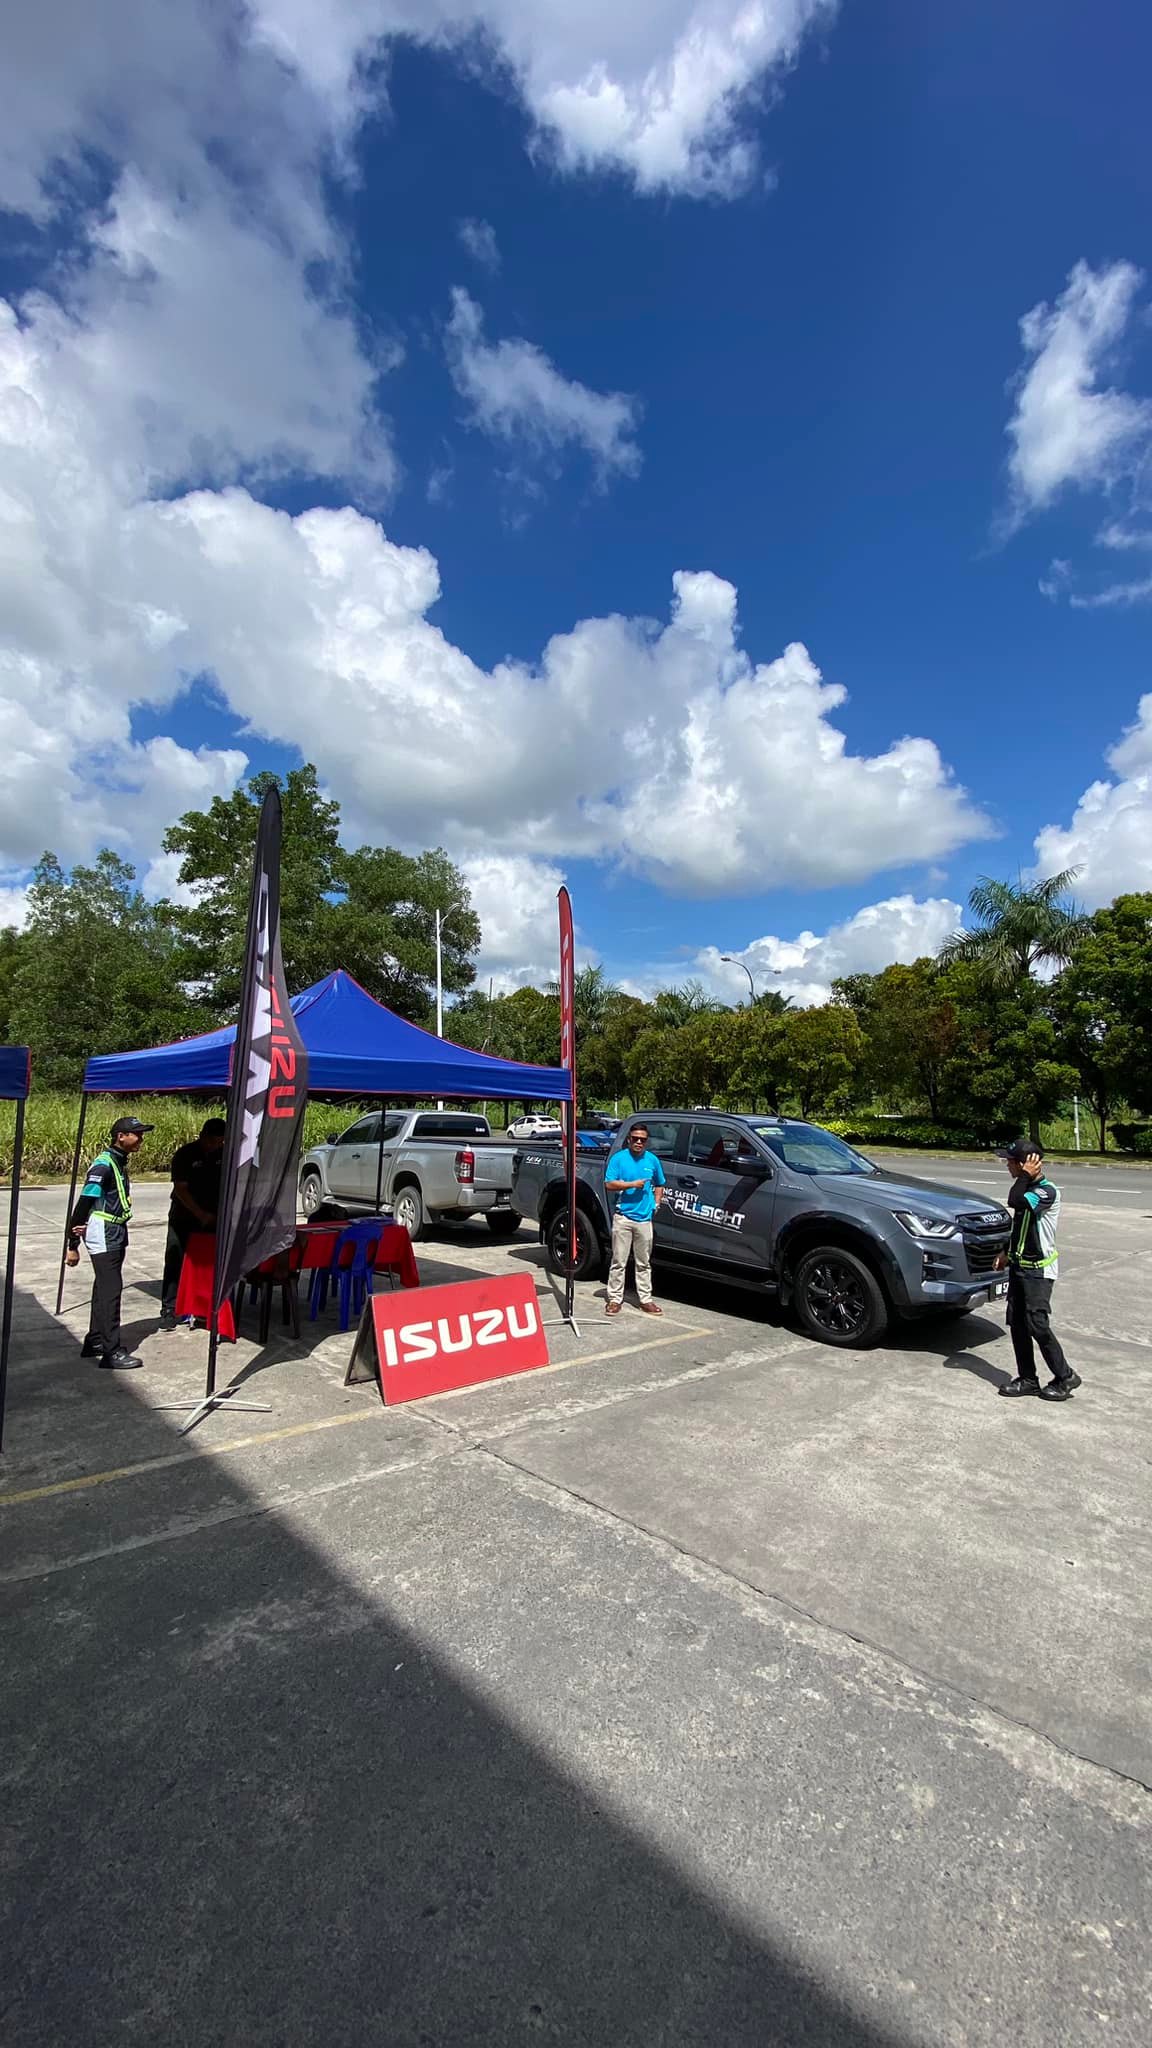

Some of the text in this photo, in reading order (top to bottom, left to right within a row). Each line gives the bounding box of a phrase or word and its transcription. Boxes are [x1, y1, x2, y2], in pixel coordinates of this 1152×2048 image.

[268, 975, 296, 1118] UZU
[674, 1190, 699, 1202] SAFETY
[383, 1302, 538, 1367] ISUZU
